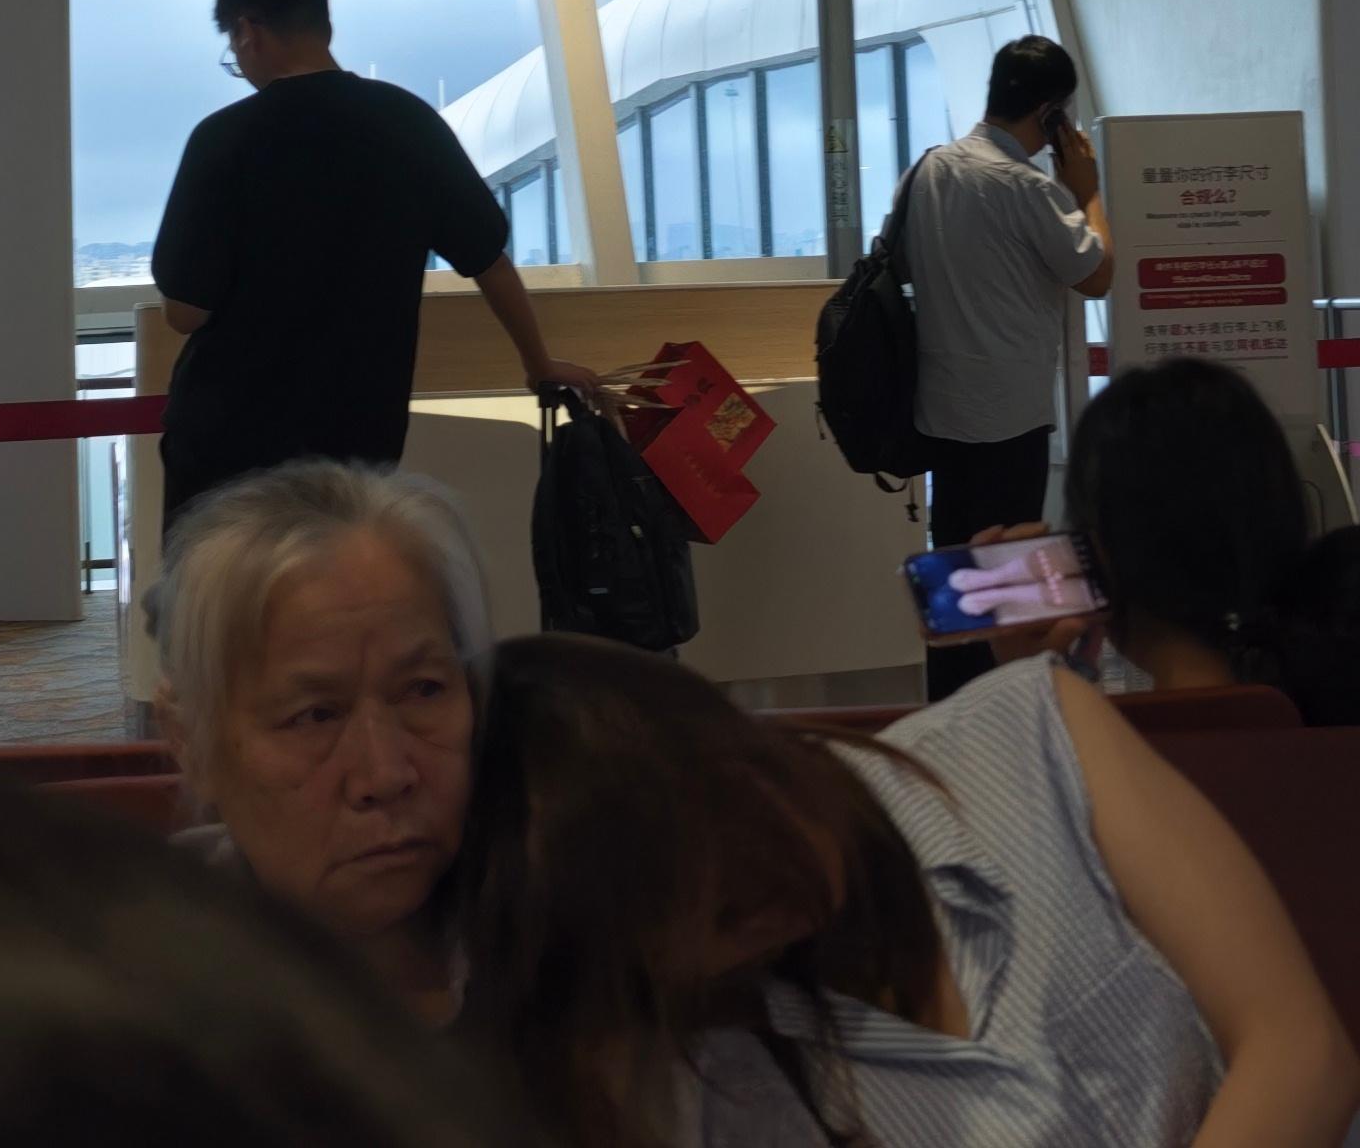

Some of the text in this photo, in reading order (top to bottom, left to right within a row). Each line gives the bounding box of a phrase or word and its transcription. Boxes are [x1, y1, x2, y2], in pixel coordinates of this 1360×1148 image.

[1142, 164, 1272, 184] 量量你的行李尺寸
